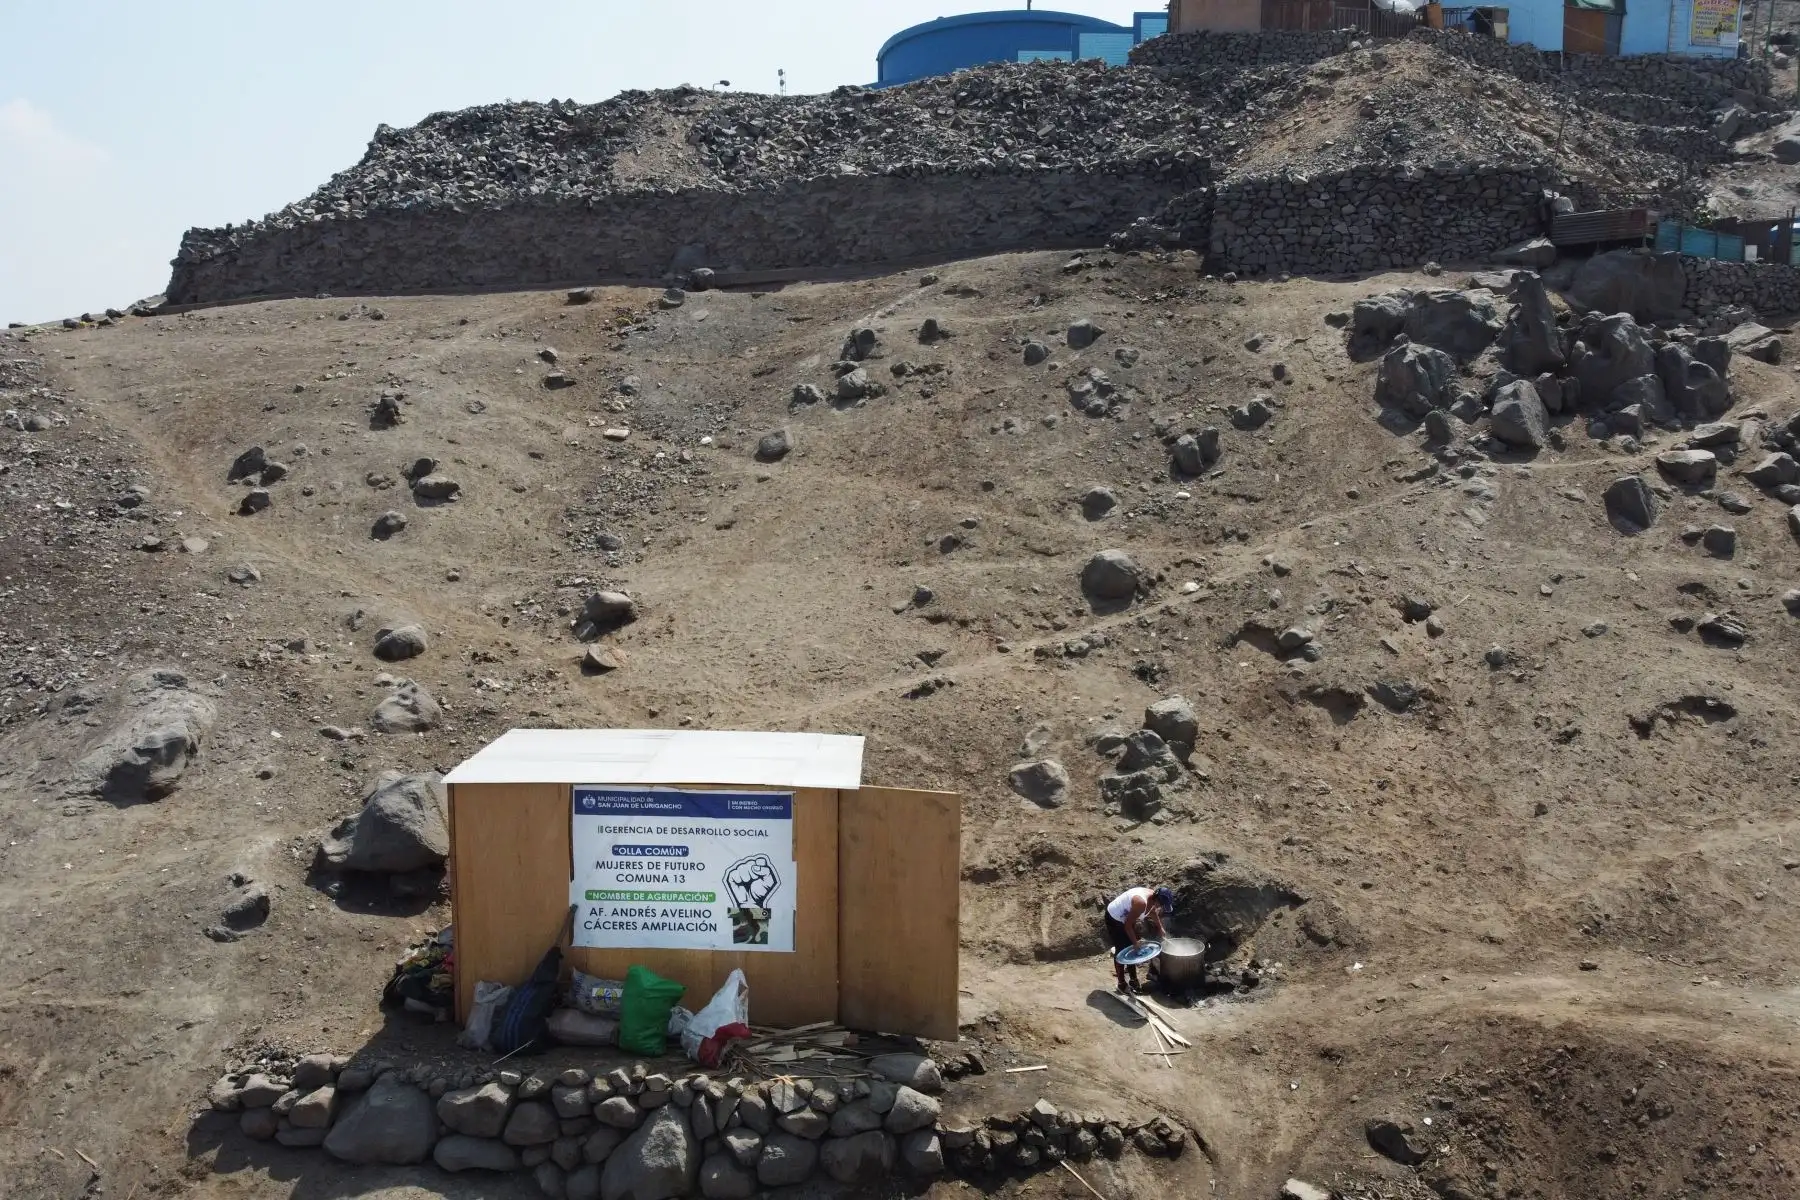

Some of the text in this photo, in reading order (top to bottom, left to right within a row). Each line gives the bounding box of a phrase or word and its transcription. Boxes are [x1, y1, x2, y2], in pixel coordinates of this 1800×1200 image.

[605, 826, 653, 834] GERENCIA
[671, 827, 731, 836] DESARROLLO
[734, 829, 768, 837] SOCIAL
[596, 861, 705, 871] MUJERES DE FUTURO
[616, 874, 685, 883] COMUNA 13
[590, 906, 712, 918] AF. ANDRÉS AVELINO
[584, 919, 717, 931] CÁCERES AMPLIACIÓN
